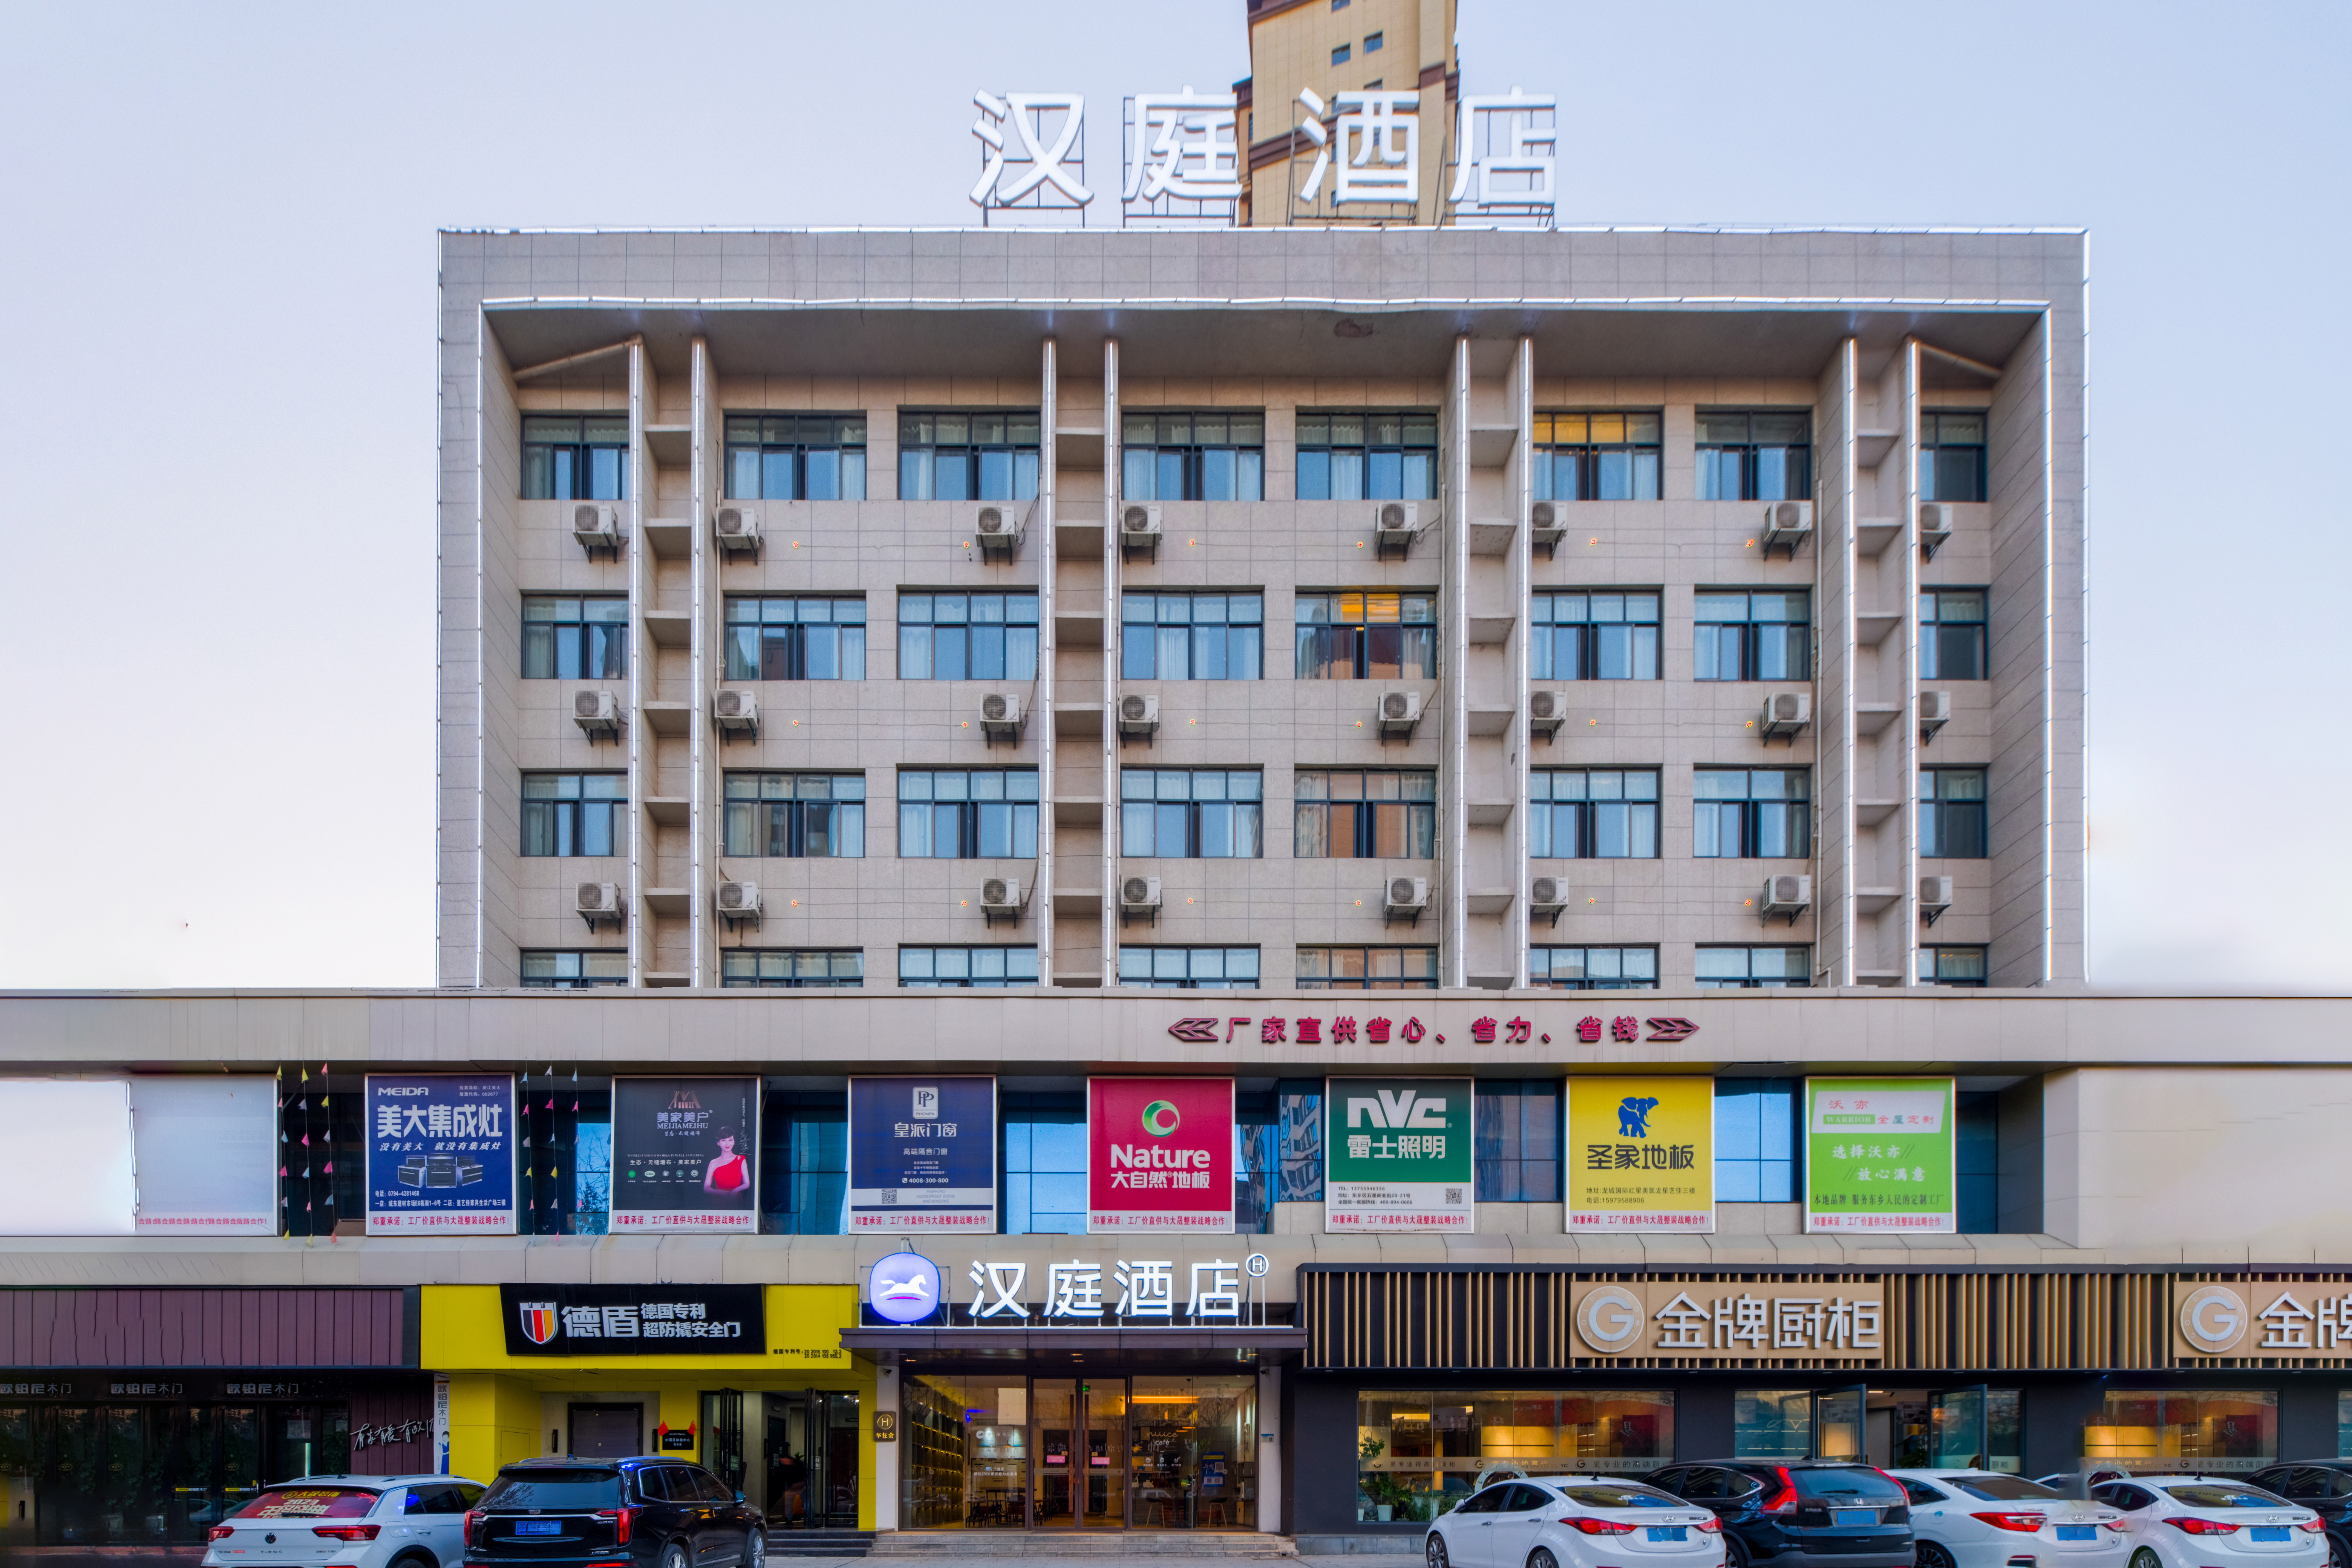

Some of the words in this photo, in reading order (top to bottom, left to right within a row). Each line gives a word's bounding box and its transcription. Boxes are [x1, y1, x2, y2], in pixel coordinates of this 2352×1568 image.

[969, 85, 1557, 206] 汉庭酒店
[1830, 1100, 1869, 1109] 沃亦
[378, 1104, 502, 1138] 美大集成灶
[657, 1112, 709, 1122] 美家美户
[1877, 1115, 1934, 1124] 全屋定制
[894, 1122, 957, 1137] 皇派门窗
[380, 1142, 424, 1151] 没有美大
[434, 1141, 502, 1150] 就没有集成灶
[1347, 1135, 1446, 1159] 雷士照明
[1833, 1145, 1900, 1159] 选择沃亦
[1111, 1144, 1211, 1168] Nature
[1588, 1144, 1694, 1170] 圣象地板
[1858, 1167, 1925, 1181] 放心满意
[1815, 1194, 1846, 1205] 本地品牌
[1853, 1194, 1943, 1205] 服务东乡人民的定制工厂
[968, 1258, 1239, 1318] 汉庭酒店
[641, 1303, 706, 1319] 德国专利
[562, 1305, 639, 1338] 德盾
[1656, 1291, 1881, 1348] 金牌厨柜
[643, 1321, 740, 1337] 超防撬安全门
[111, 1383, 182, 1393] 欧铂尼木门
[227, 1383, 299, 1393] 欧铂尼木门
[438, 1386, 447, 1425] 欧铂尼木门
